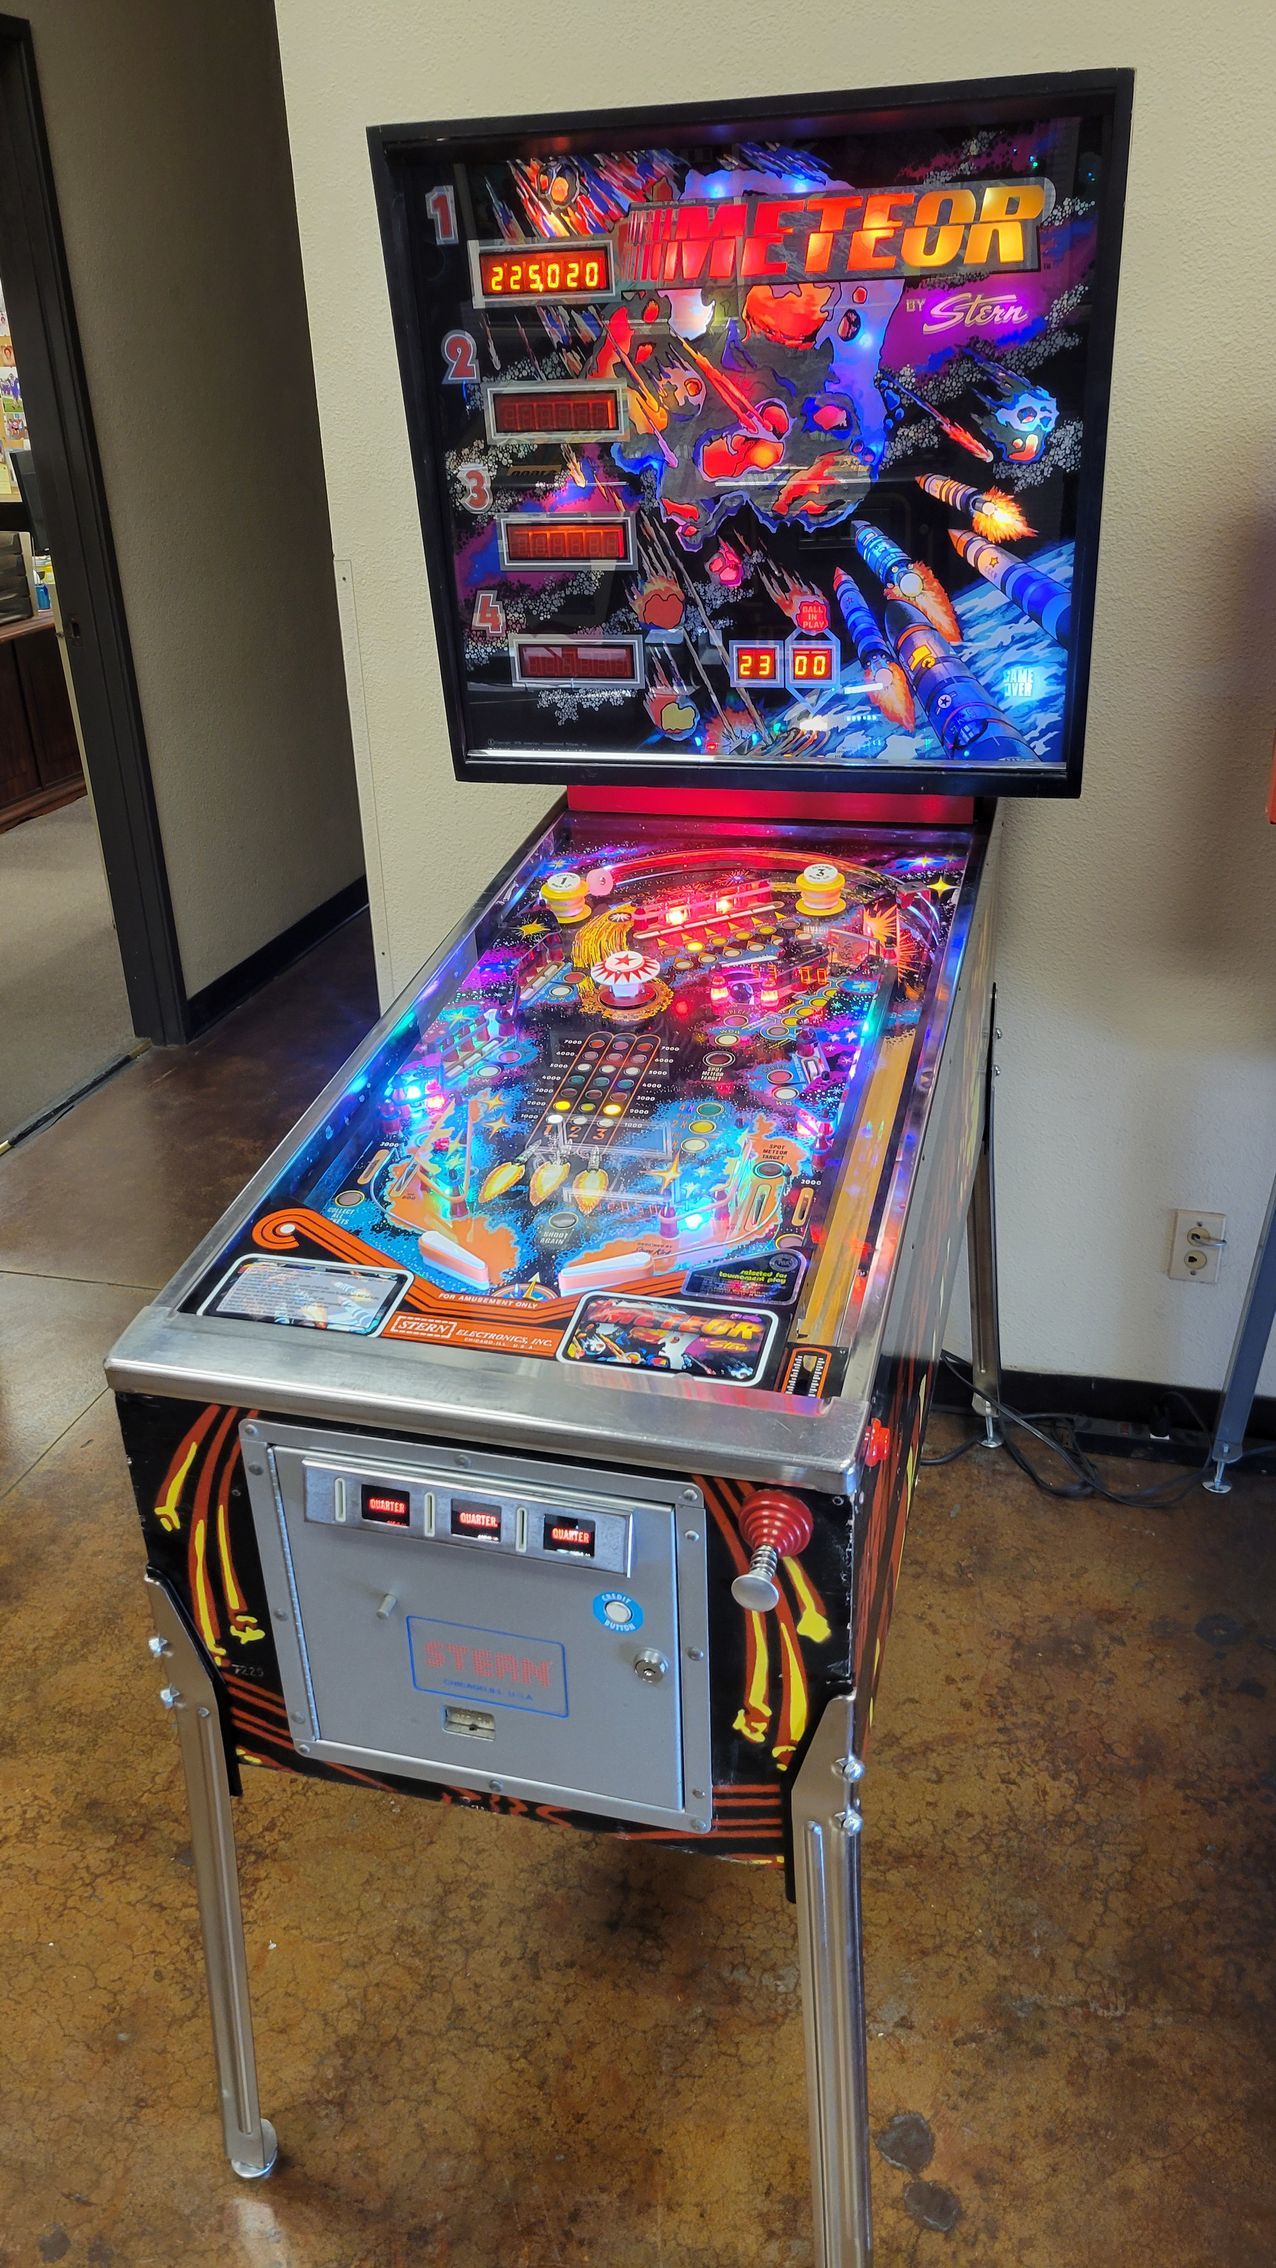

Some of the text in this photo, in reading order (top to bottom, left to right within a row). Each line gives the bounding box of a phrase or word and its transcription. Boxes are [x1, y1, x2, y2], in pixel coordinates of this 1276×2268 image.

[426, 188, 458, 242] 1
[624, 184, 1046, 281] METEOR
[491, 261, 599, 292] 225,020
[906, 292, 1028, 335] BY Stern
[443, 332, 478, 381] 2
[460, 467, 490, 511] 3
[474, 592, 503, 635] 4
[740, 655, 771, 676] 23
[795, 655, 826, 676] 00
[544, 1125, 553, 1136] 1
[568, 1126, 581, 1138] 2
[593, 1128, 608, 1140] 3
[458, 1295, 513, 1307] AMUSEMENT
[515, 1301, 538, 1309] ONLY
[399, 1320, 450, 1334] STERN
[455, 1329, 553, 1347] ELECTRONICS, INC.
[370, 1498, 406, 1514] QUARTER
[552, 1528, 590, 1544] QUARTER
[601, 1593, 631, 1604] CREDIT
[604, 1619, 636, 1632] BUTTON
[424, 1640, 551, 1688] STERN
